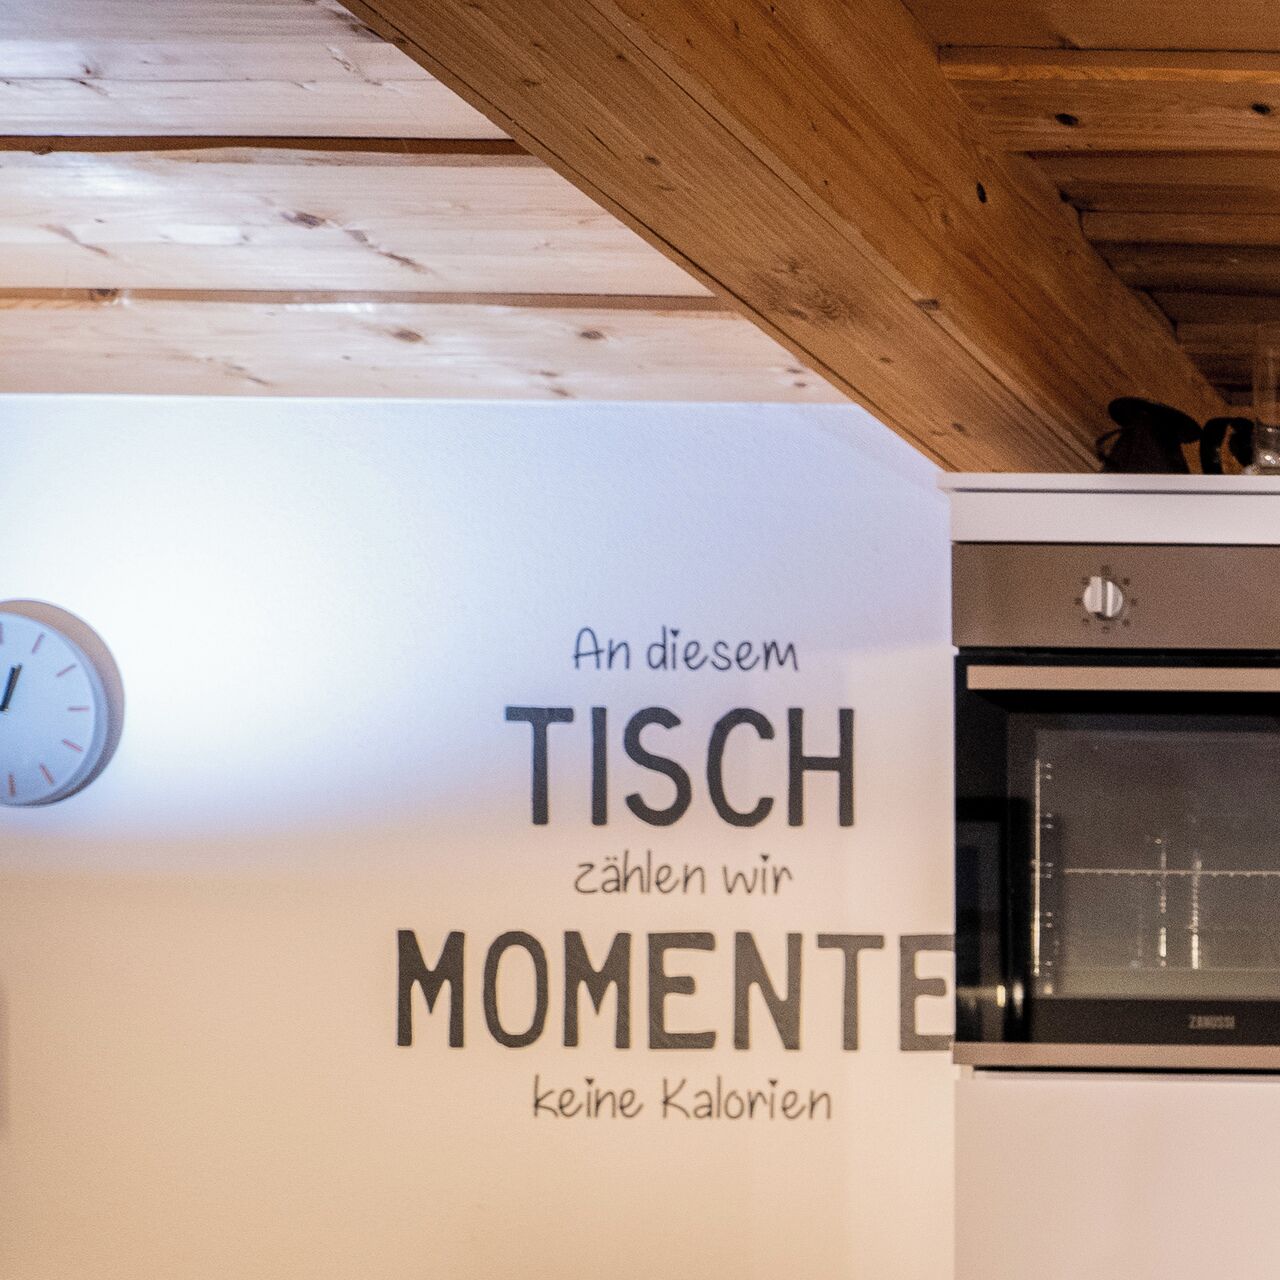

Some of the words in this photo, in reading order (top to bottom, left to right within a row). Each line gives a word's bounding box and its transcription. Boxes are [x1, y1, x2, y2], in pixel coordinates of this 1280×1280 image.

[572, 626, 631, 670] An
[646, 625, 799, 673] diesem
[504, 705, 856, 829] TISCH
[573, 849, 706, 895] zählen
[722, 853, 793, 896] wir
[395, 928, 953, 1053] MOMENTE
[532, 1074, 644, 1119] keine
[661, 1075, 833, 1121] Kalorien
